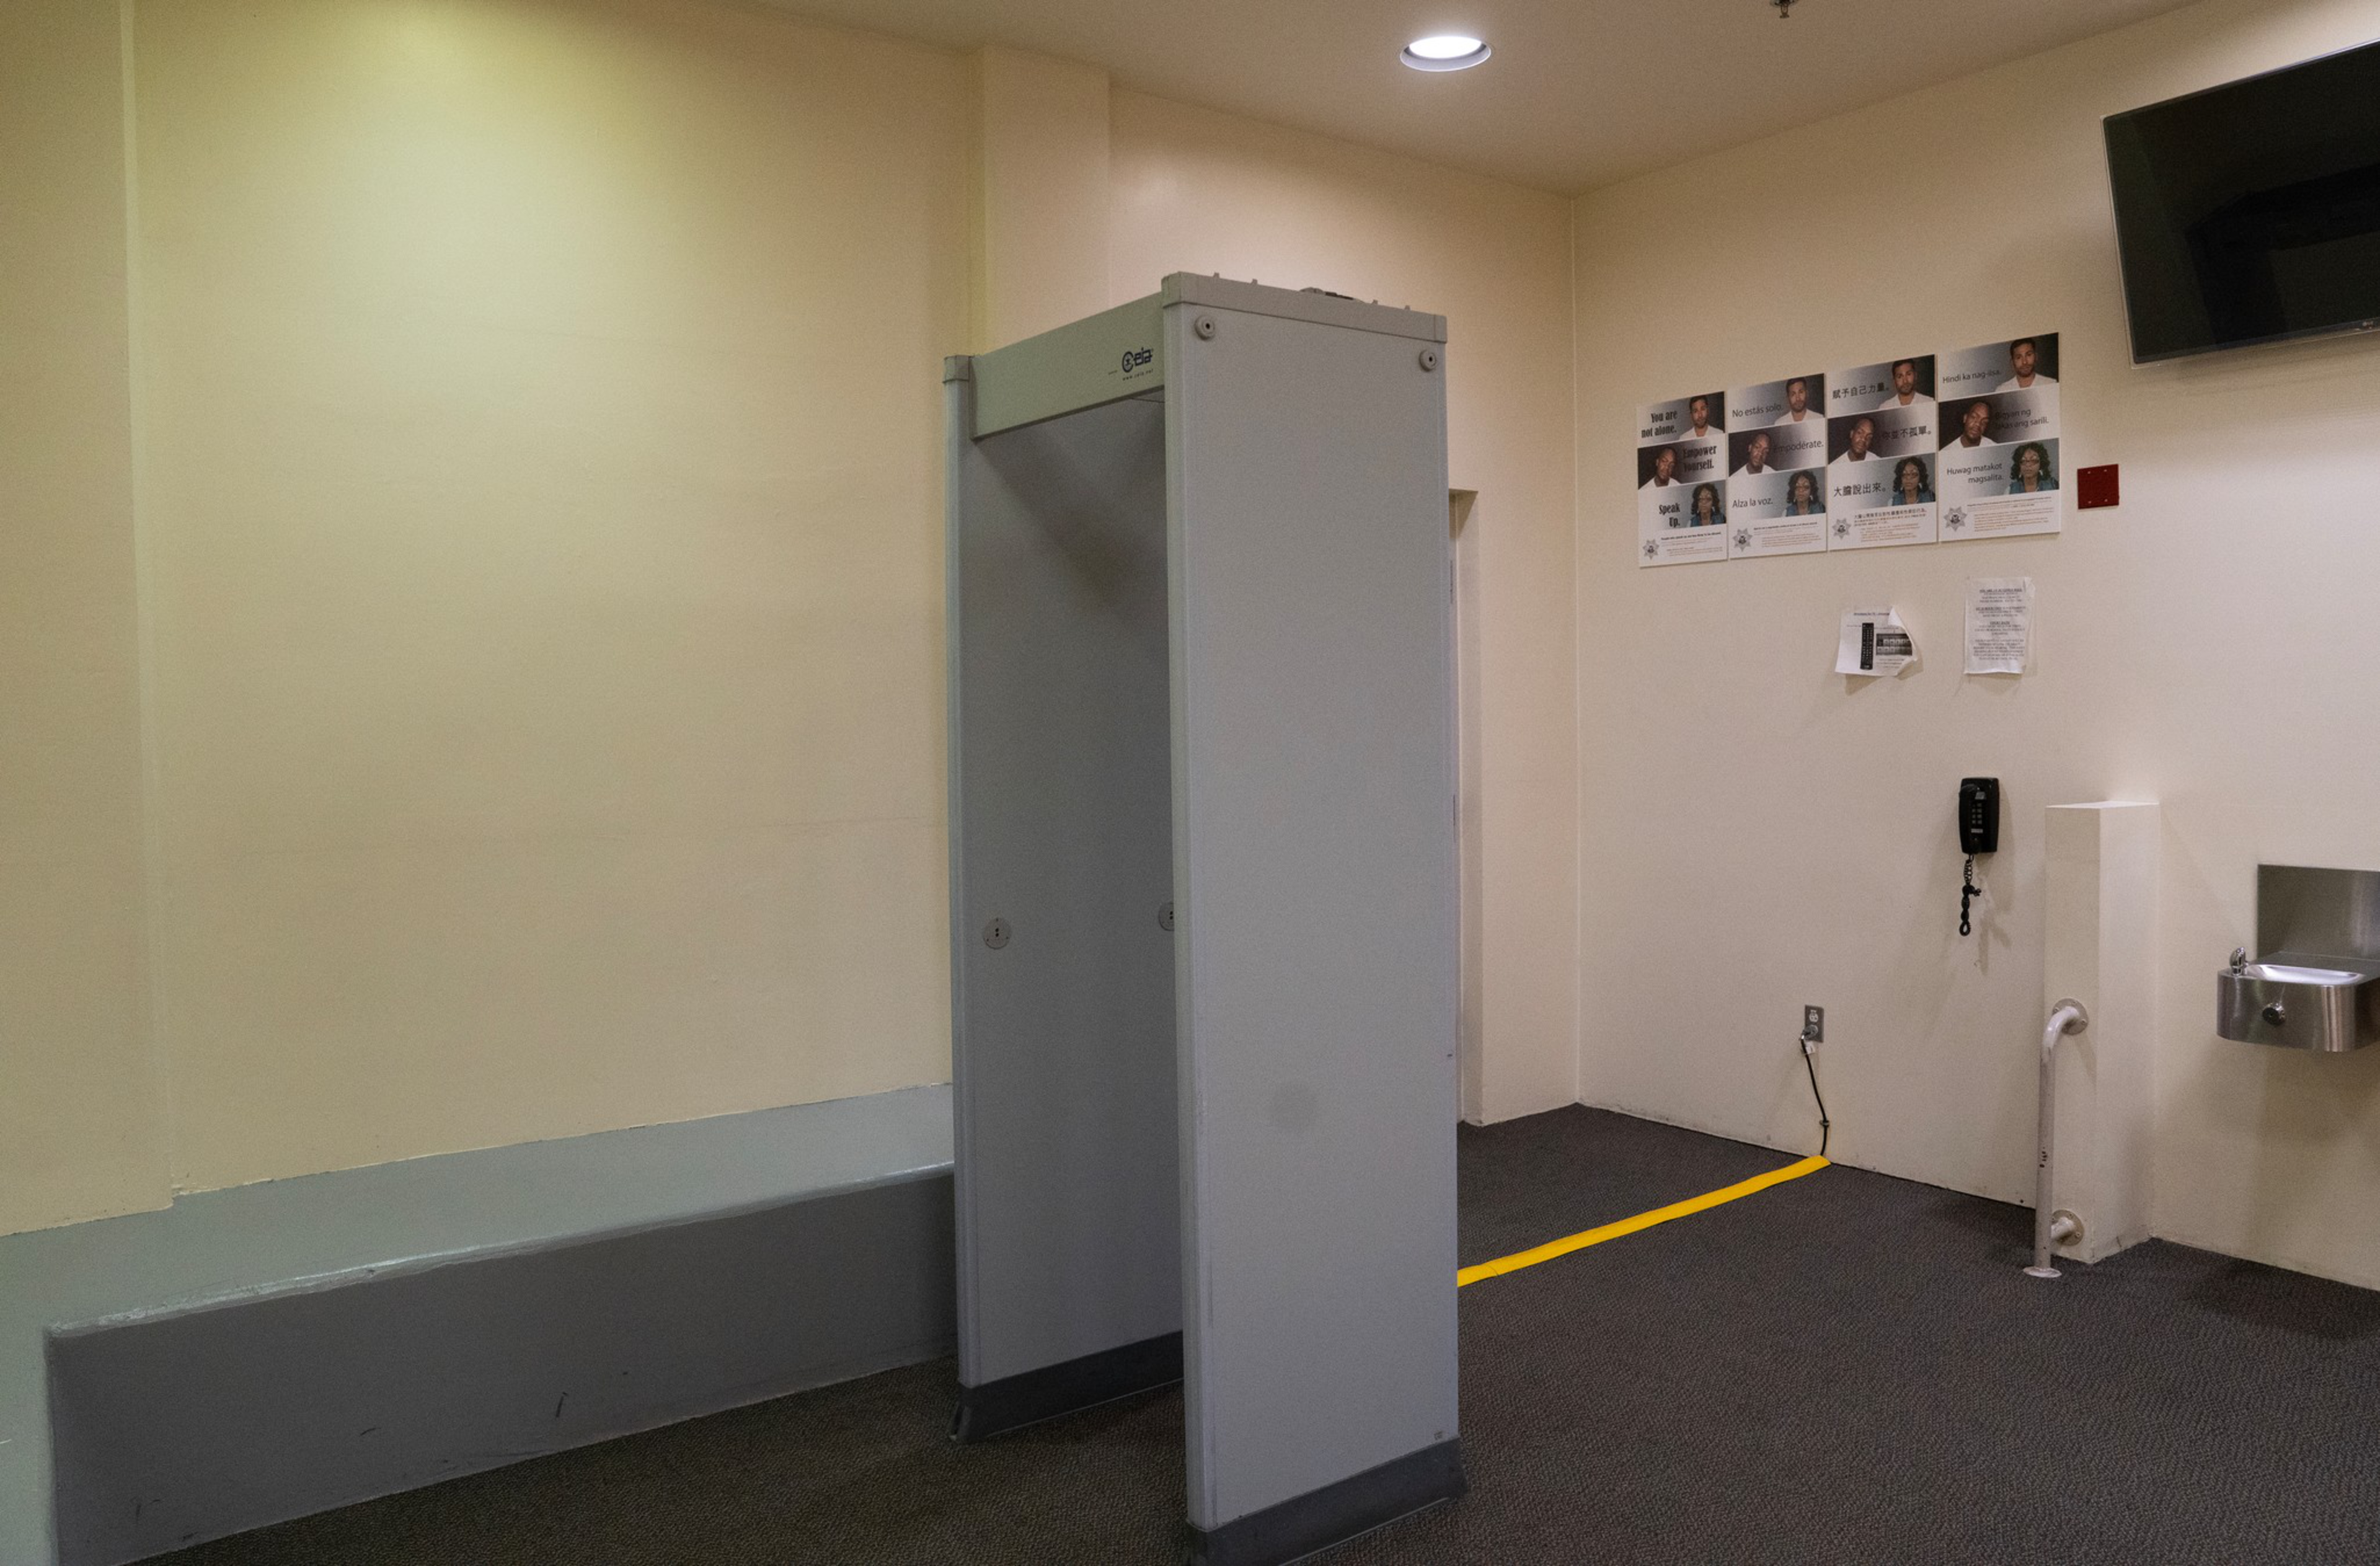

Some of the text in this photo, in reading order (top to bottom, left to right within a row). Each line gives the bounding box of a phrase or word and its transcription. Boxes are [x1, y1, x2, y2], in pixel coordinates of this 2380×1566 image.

[1943, 373, 1962, 383] Hindi
[1962, 372, 1971, 381] ka
[1732, 402, 1784, 417] No estás solo.
[2020, 409, 2031, 418] ng
[1651, 410, 1678, 423] You are
[2014, 420, 2028, 428] ang
[2030, 416, 2049, 426] sarili.
[1641, 425, 1677, 438] not alone.
[1683, 445, 1717, 459] Empower
[1774, 440, 1824, 454] Empodérate.
[1683, 459, 1714, 472] Yourself.
[1947, 463, 2002, 476] Huwag matakot
[1968, 474, 2004, 484] magsalita.
[1658, 502, 1681, 516] Speak
[1732, 497, 1773, 508] Alza la voz.
[1669, 516, 1681, 528] Up.
